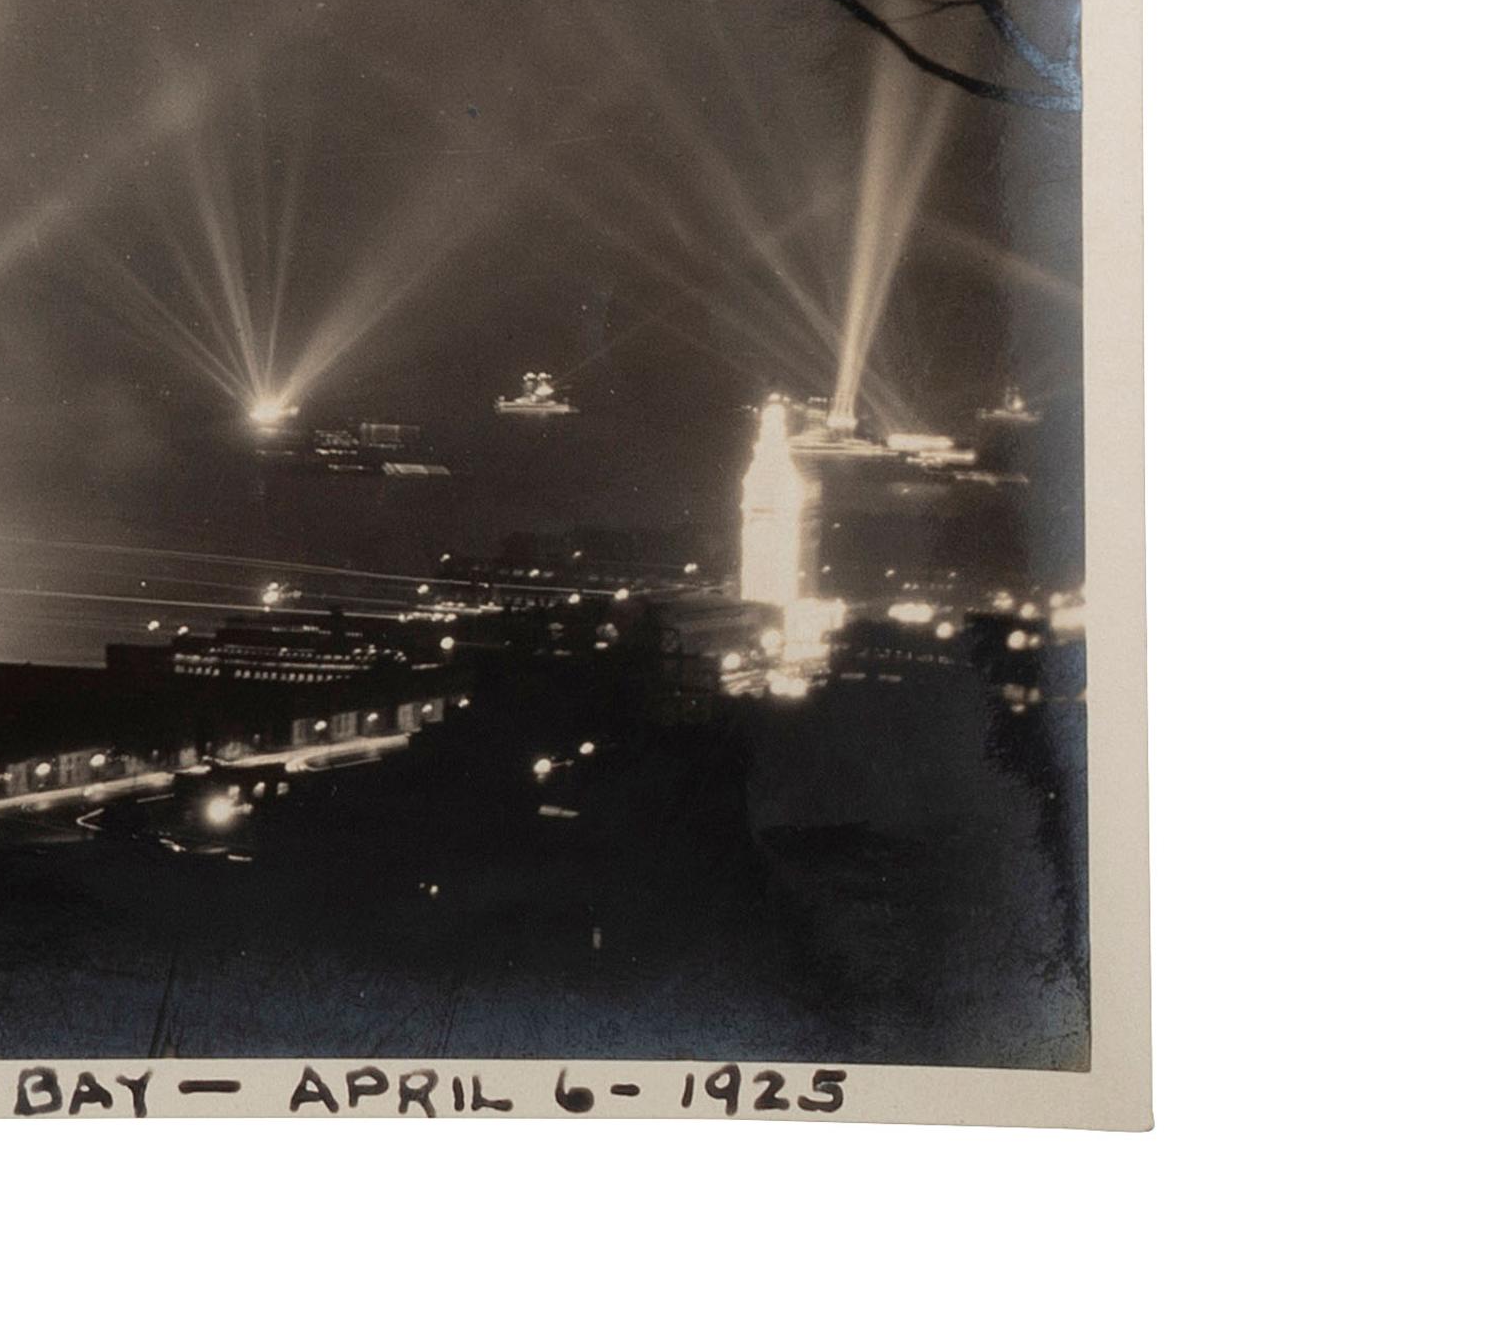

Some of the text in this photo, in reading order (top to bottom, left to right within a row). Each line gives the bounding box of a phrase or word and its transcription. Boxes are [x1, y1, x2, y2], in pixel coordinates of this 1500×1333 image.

[13, 1067, 151, 1120] BAY
[289, 1066, 514, 1119] APRIL
[681, 1066, 848, 1116] 1925
